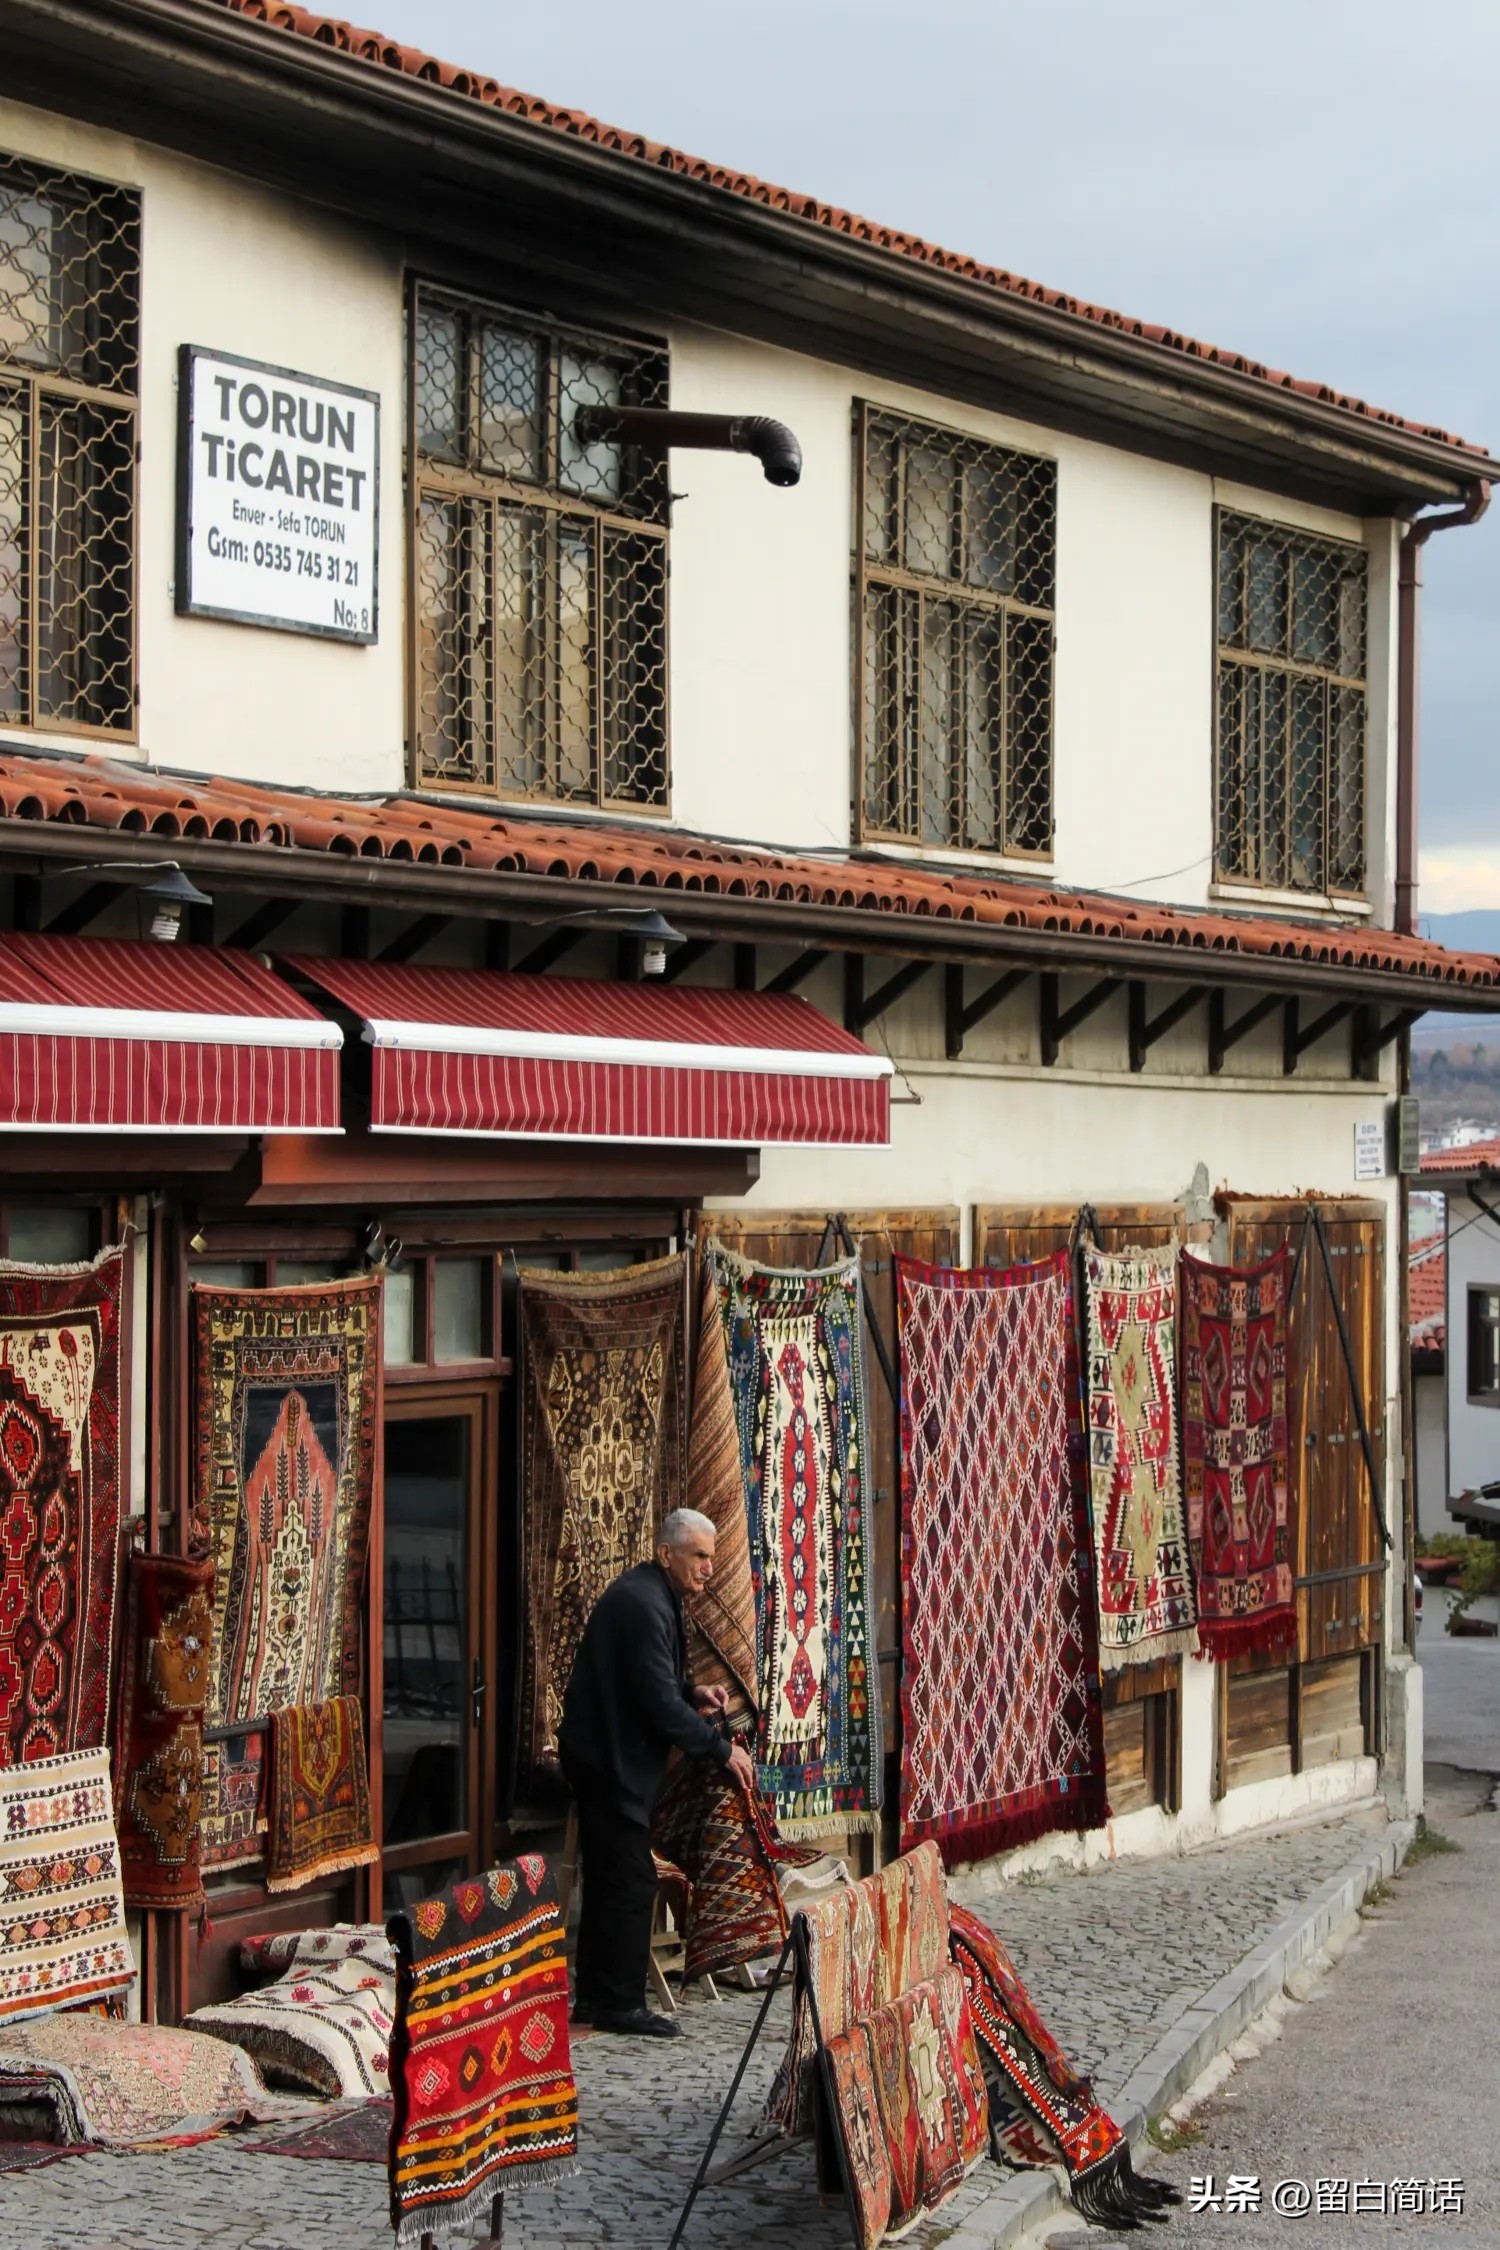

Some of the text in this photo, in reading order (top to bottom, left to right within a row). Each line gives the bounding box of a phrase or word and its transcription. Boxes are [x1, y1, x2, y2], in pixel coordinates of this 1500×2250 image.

[214, 375, 355, 453] TORUN
[232, 498, 266, 525] Enver
[277, 509, 301, 534] Sefa
[304, 515, 346, 545] TORUN
[208, 526, 359, 587] Gsm: 0535 745 31 21
[334, 598, 369, 632] No: 8
